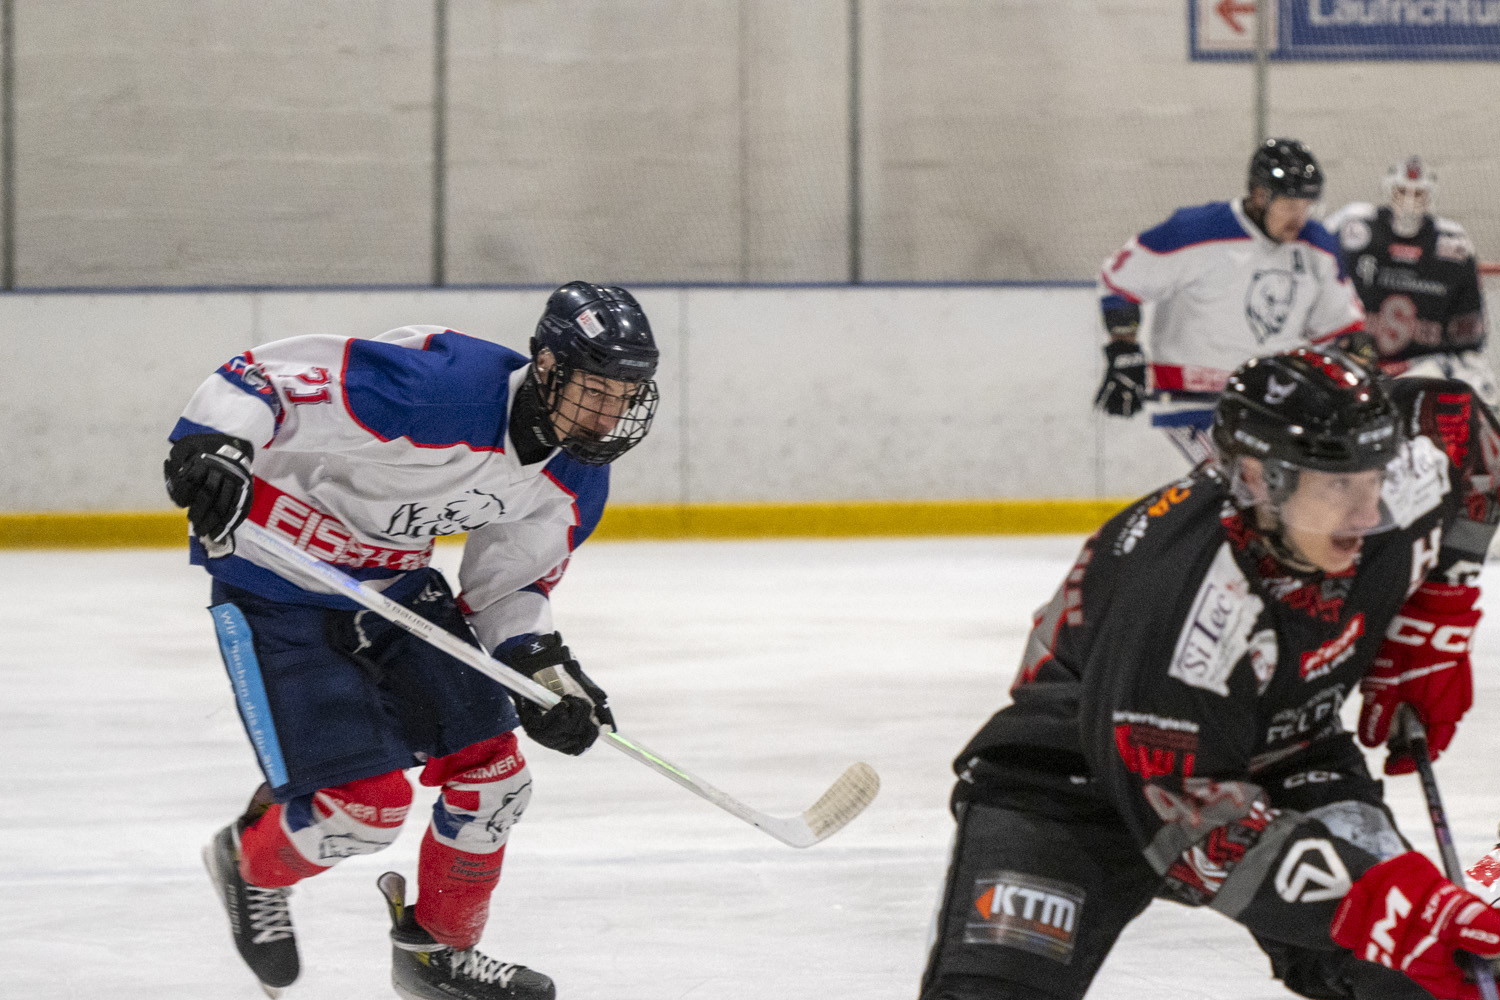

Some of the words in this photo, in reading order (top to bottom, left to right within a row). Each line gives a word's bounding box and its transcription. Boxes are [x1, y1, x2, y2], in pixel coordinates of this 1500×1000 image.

[220, 610, 237, 635] Wir
[1385, 615, 1474, 653] CC
[990, 884, 1075, 933] KTM
